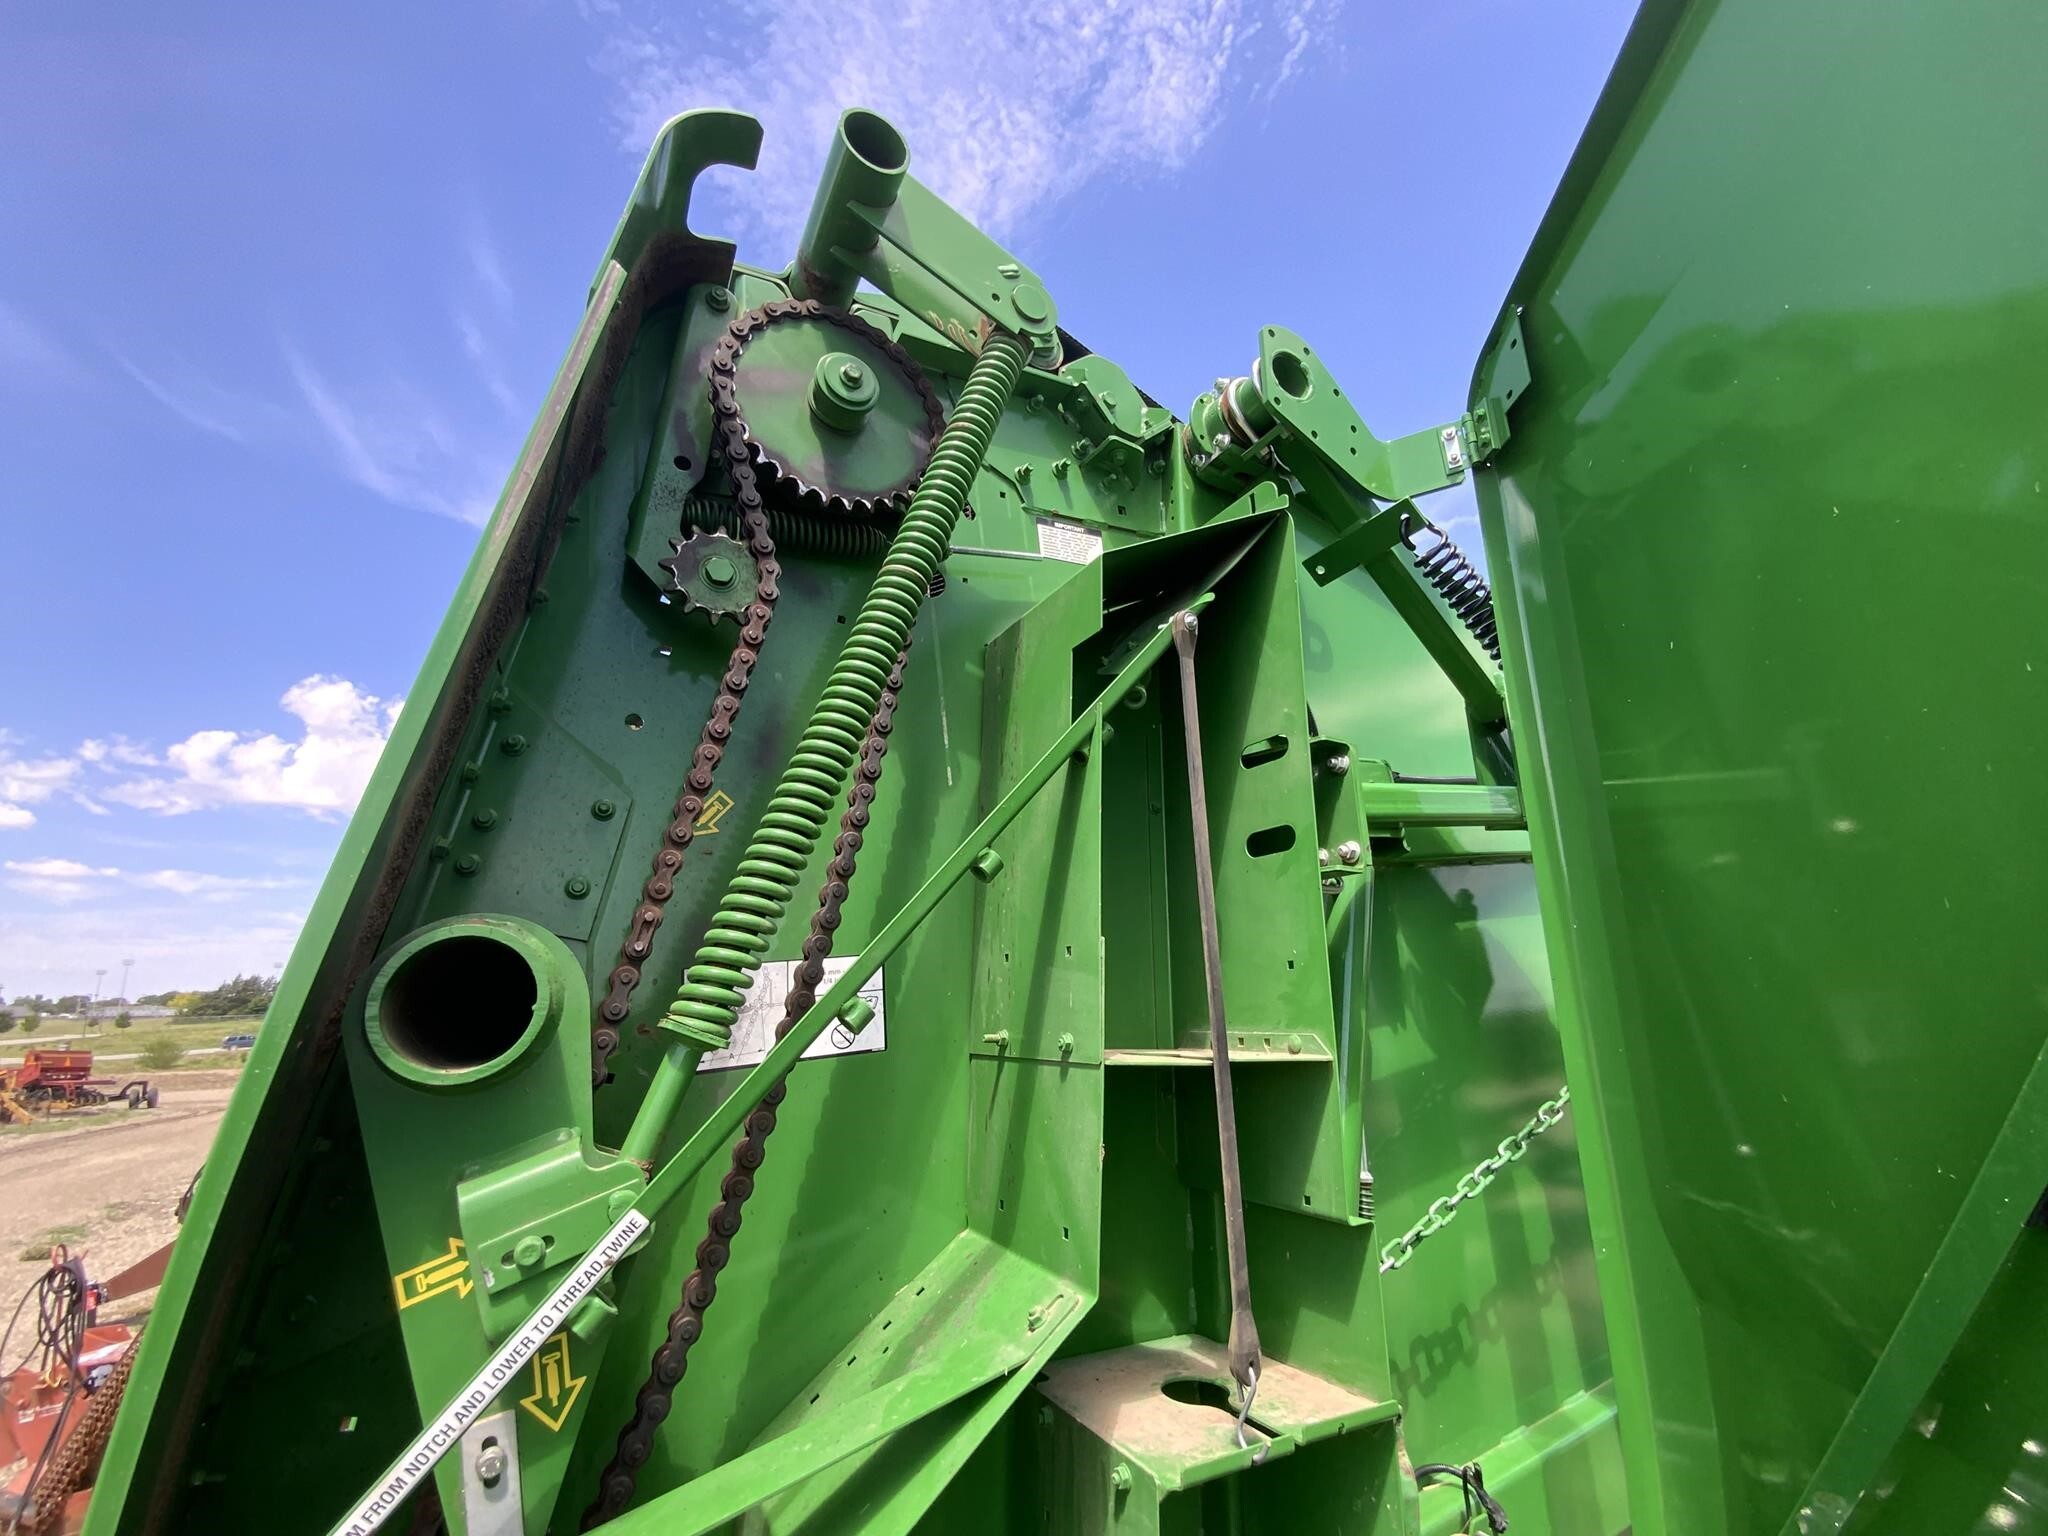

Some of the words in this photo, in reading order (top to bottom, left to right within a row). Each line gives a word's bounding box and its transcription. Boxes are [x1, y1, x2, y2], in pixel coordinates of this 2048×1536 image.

[361, 1476, 408, 1525] FROM
[404, 1423, 457, 1479] NOTCH
[453, 1390, 486, 1425] AND
[482, 1336, 537, 1391] LOWER
[532, 1315, 555, 1337] TO
[551, 1259, 603, 1315] THREAD
[601, 1216, 643, 1260] TWINE
